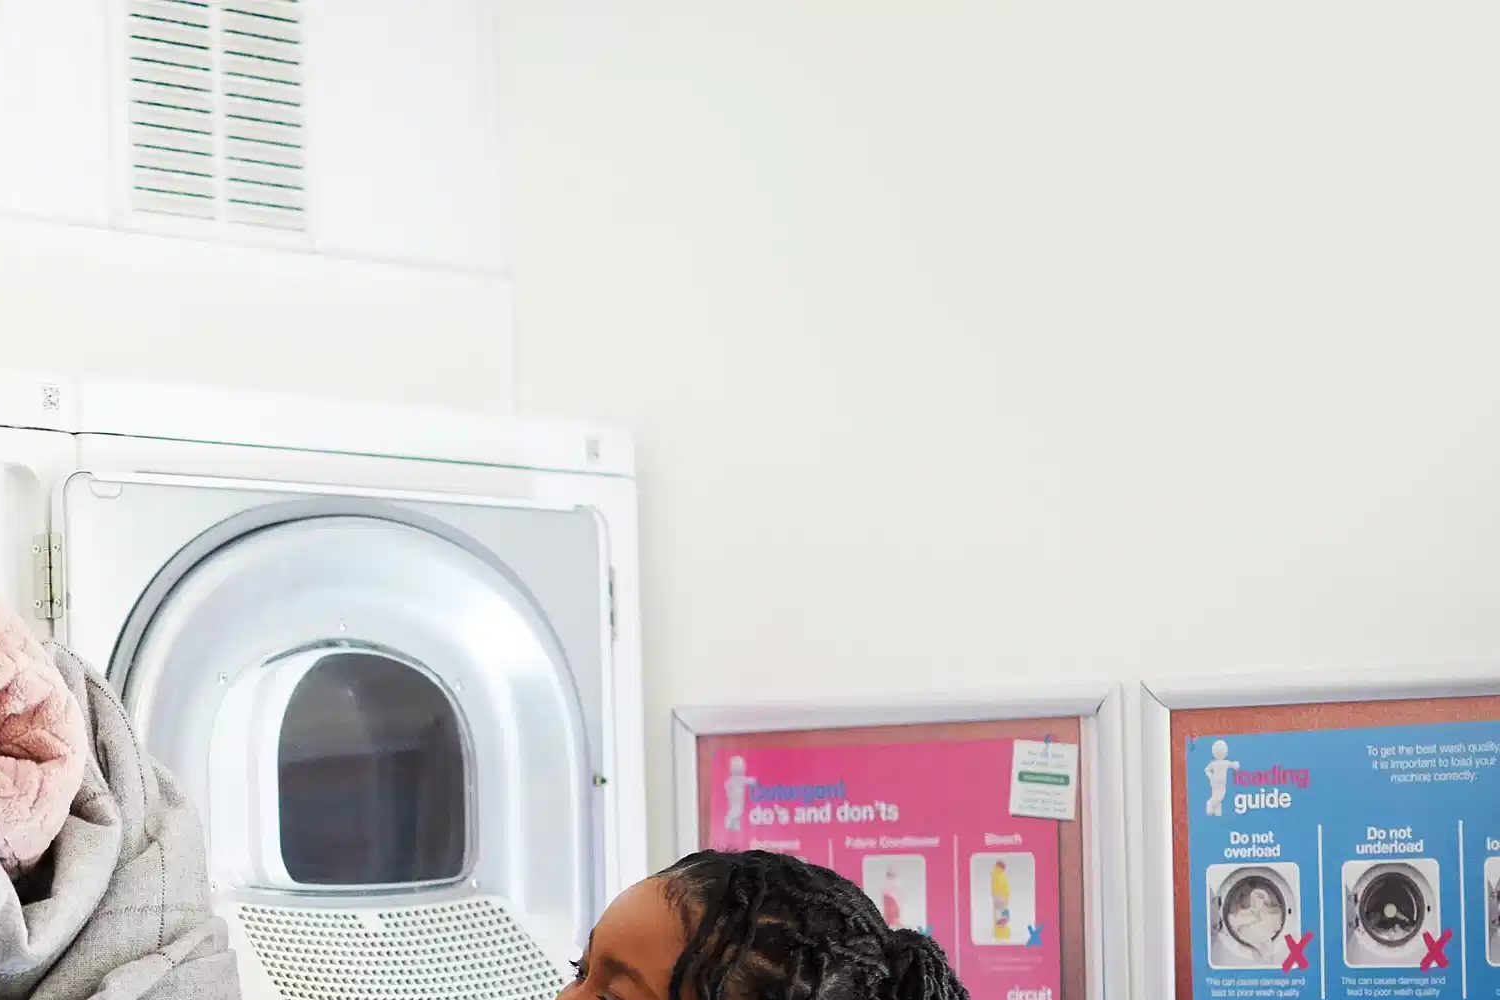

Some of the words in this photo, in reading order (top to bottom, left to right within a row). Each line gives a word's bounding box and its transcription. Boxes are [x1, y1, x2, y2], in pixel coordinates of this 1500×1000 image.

[1367, 745, 1379, 756] To
[1380, 746, 1396, 758] get
[1398, 745, 1414, 755] the
[1416, 744, 1437, 754] best
[1440, 742, 1466, 753] wash
[1390, 758, 1438, 770] important
[1439, 759, 1449, 767] to
[1451, 757, 1473, 767] load
[1475, 757, 1497, 768] your
[1233, 763, 1310, 789] loading
[1390, 772, 1432, 782] machine
[1234, 788, 1292, 814] guide
[749, 804, 790, 825] do's
[793, 802, 832, 824] and
[836, 800, 899, 824] don'ts
[1230, 831, 1249, 844] Do
[1251, 830, 1274, 844] not
[1367, 826, 1386, 840] Do
[1389, 826, 1413, 839] not
[1224, 844, 1281, 859] overload
[1356, 839, 1424, 854] underload
